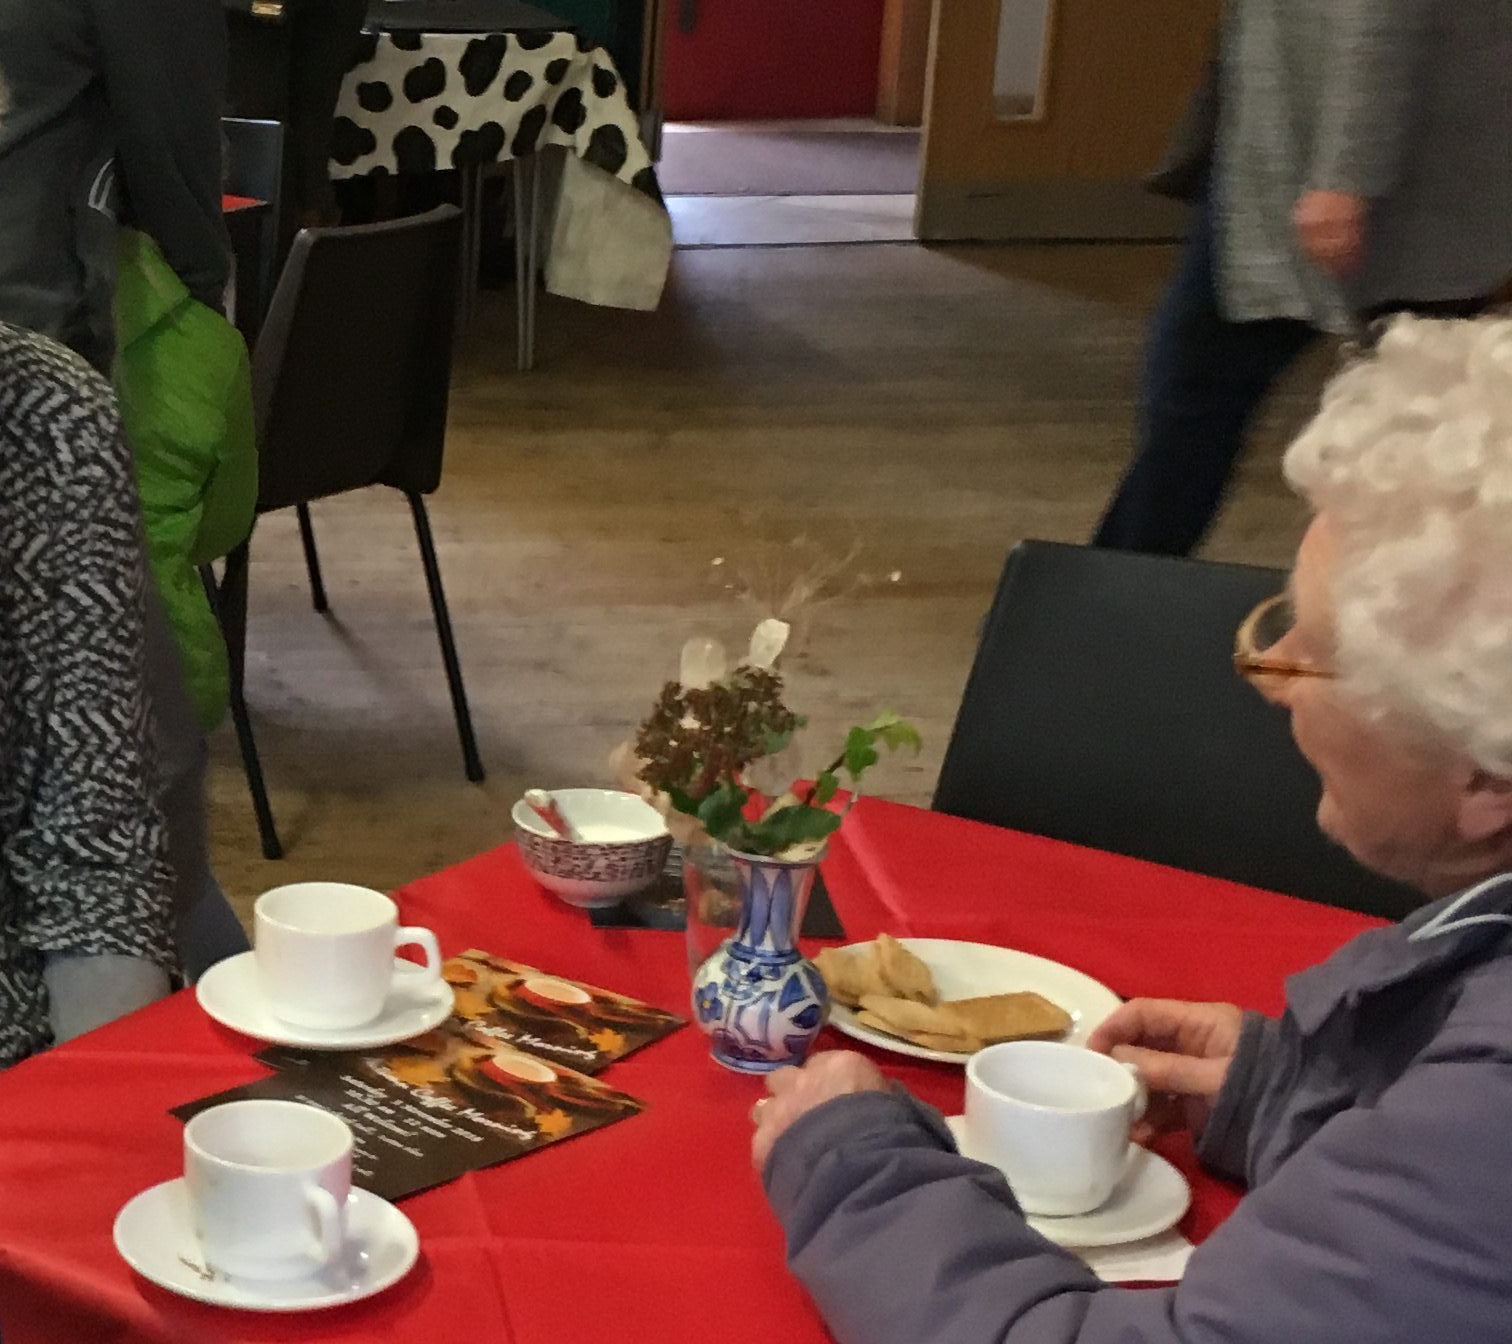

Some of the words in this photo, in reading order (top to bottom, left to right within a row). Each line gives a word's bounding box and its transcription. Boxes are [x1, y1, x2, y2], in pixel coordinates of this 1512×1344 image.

[515, 1035, 598, 1061] Morning
[409, 1088, 458, 1112] Coffee
[455, 1107, 538, 1141] Morning
